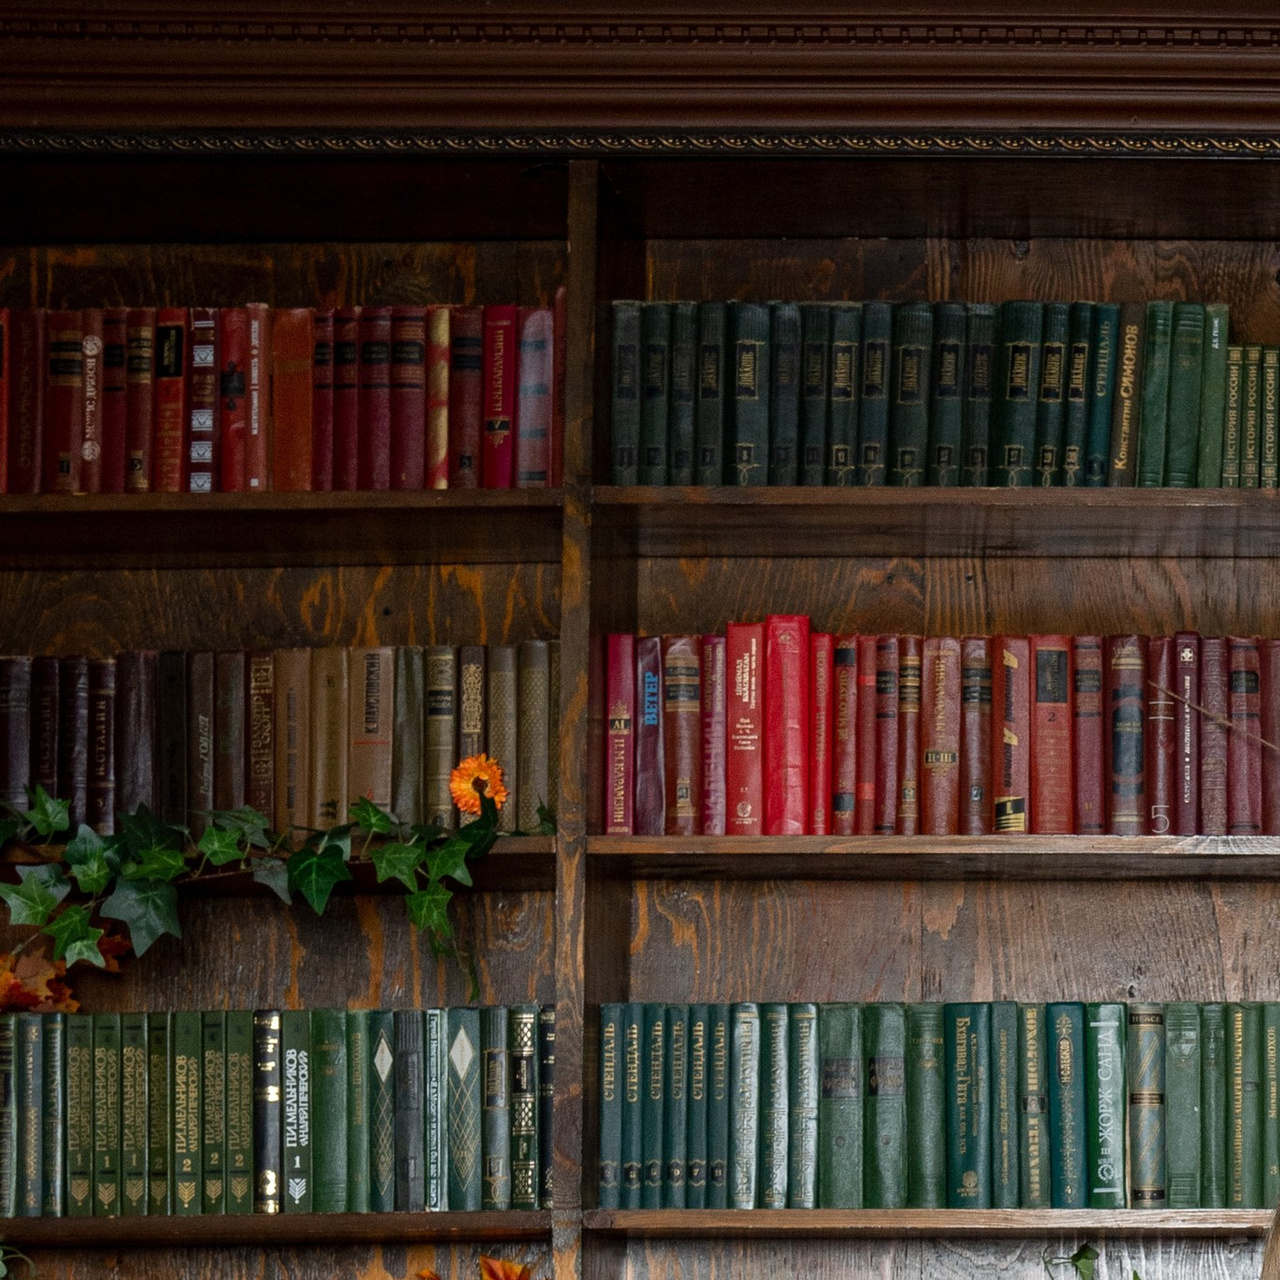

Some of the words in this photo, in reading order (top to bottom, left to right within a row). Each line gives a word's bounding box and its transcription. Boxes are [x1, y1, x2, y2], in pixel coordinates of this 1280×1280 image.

[1096, 319, 1110, 397] СТЕНДАЛЬ
[1119, 325, 1138, 398] СИМОНОВ
[644, 671, 659, 726] ВЕТЕР
[1150, 804, 1169, 833] 5
[604, 1022, 616, 1102] СТЕНДАЛЬ
[626, 1023, 638, 1103] СТЕНДАЛЬ
[650, 1020, 663, 1101] СТЕНДАЛЬ
[693, 1020, 705, 1101] СТЕНДАЛЬ
[1100, 1031, 1113, 1073] САНД
[1098, 1077, 1113, 1138] ЖОРЖ
[182, 1158, 191, 1171] 2
[210, 1152, 218, 1165] 2
[293, 1156, 300, 1168] 1
